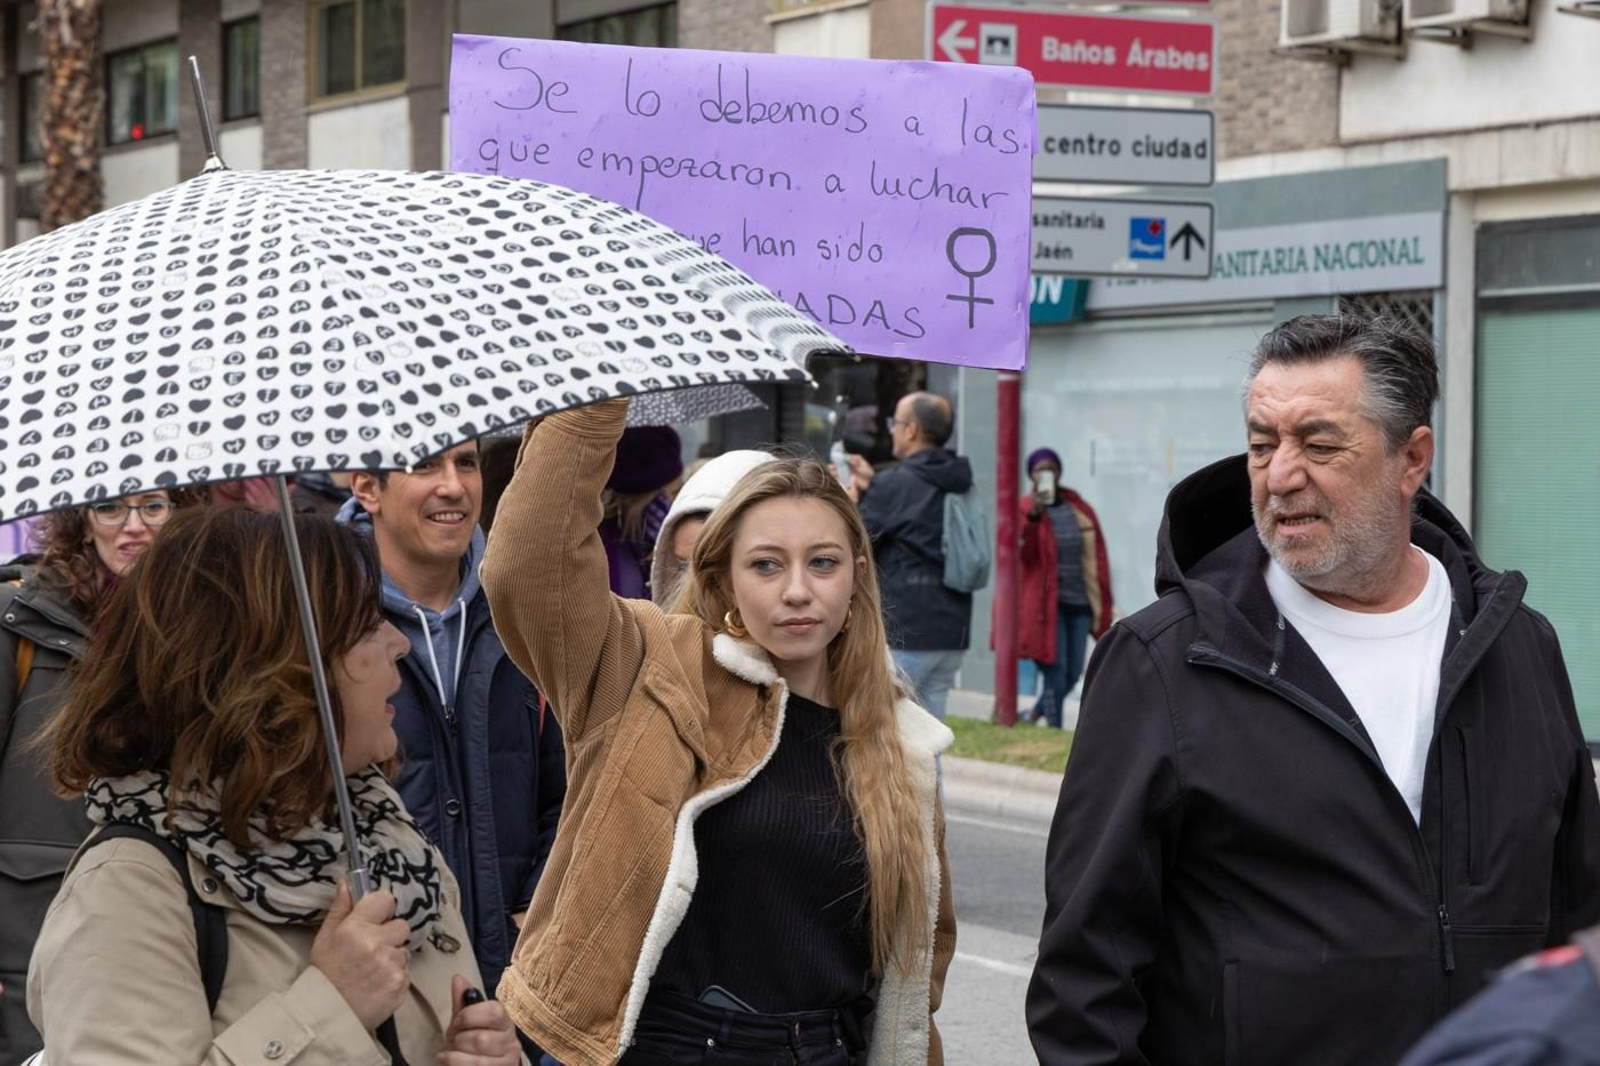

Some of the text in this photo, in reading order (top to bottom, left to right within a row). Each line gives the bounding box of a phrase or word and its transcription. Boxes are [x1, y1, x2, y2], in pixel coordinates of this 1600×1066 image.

[1042, 35, 1209, 71] Baños Árabes
[494, 47, 577, 113] Se
[626, 57, 661, 117] lo
[700, 63, 867, 133] debemos
[904, 115, 924, 136] a
[1043, 133, 1208, 158] centro ciudad
[479, 138, 1009, 211] que empezaron a luchar
[690, 217, 883, 263] ue han sido
[1035, 241, 1073, 259] Jaén
[1213, 237, 1425, 278] ANITARIA NACIONAL
[778, 290, 925, 338] ADAS
